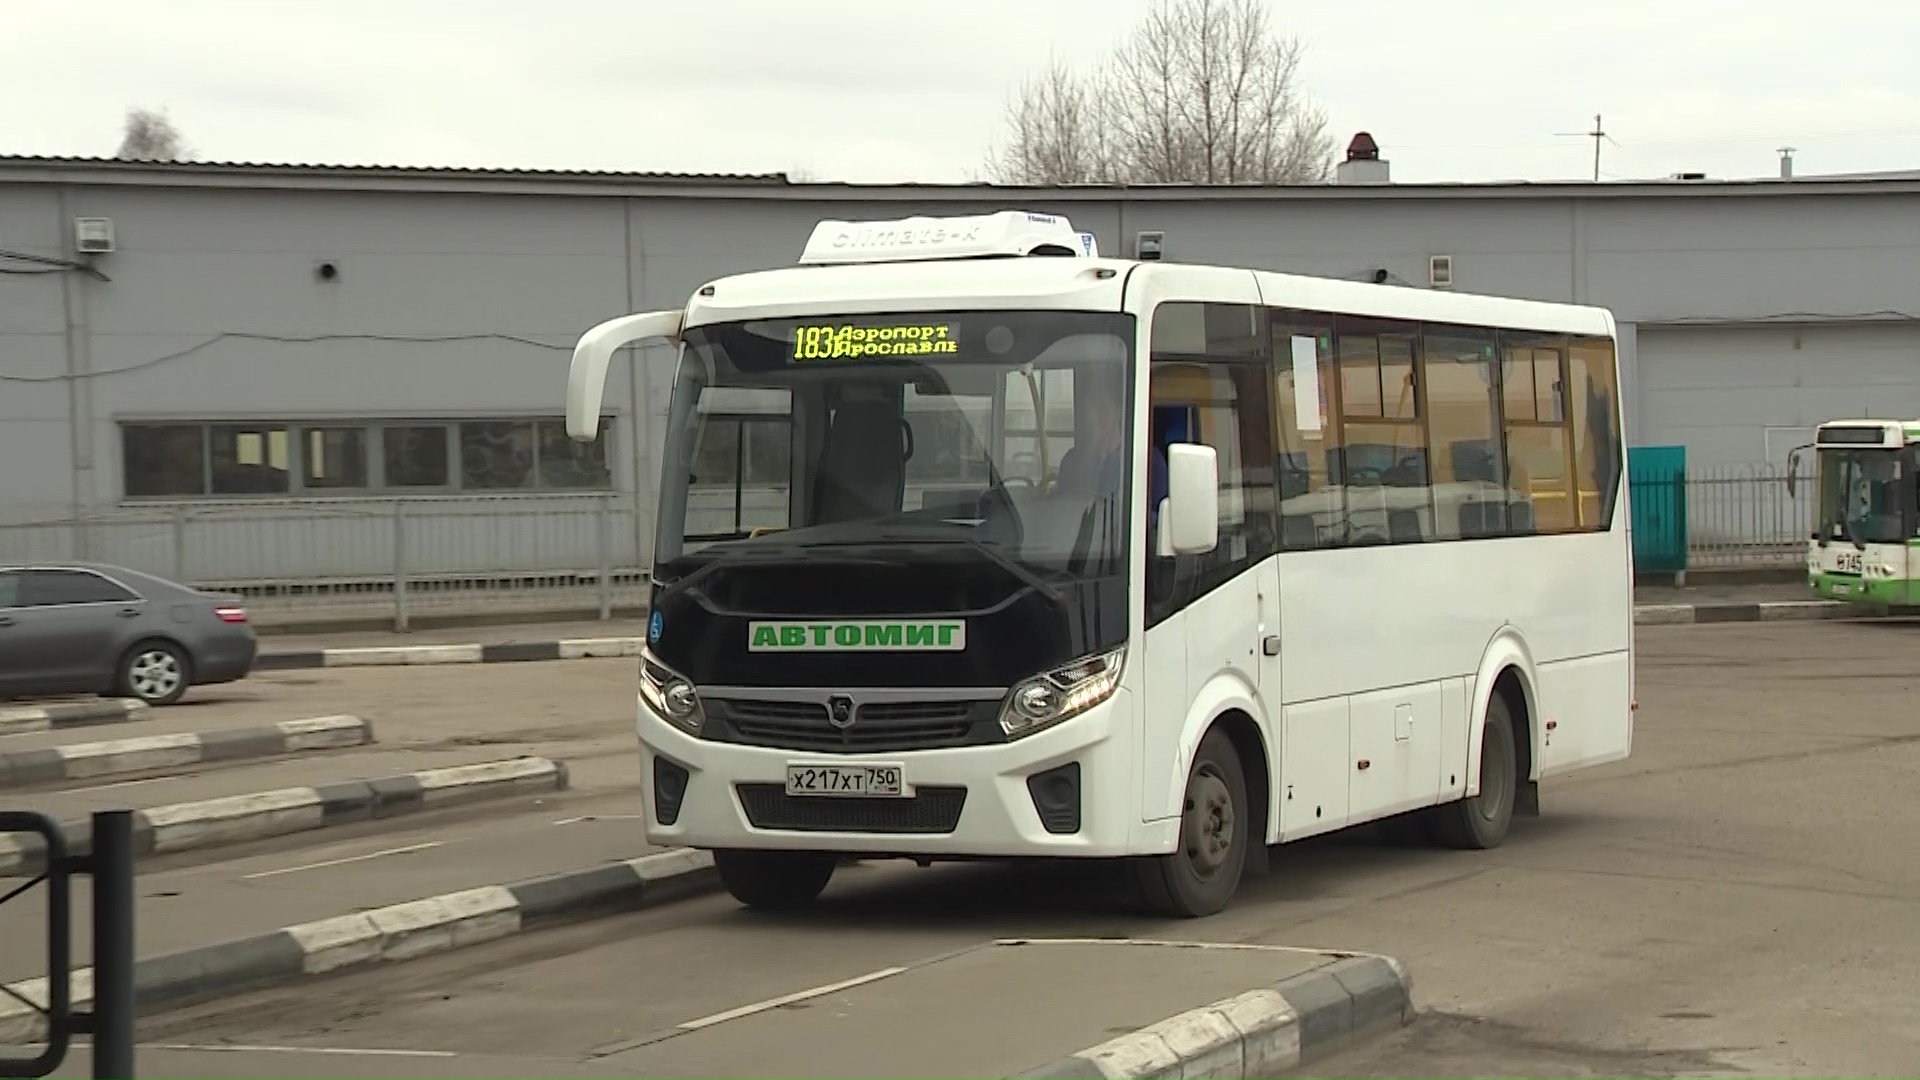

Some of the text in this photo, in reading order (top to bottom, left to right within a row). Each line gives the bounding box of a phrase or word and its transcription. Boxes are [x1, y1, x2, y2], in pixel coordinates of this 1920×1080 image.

[838, 325, 949, 343] Аэропорт
[752, 625, 961, 647] АВТОМИГ
[868, 769, 896, 786] 750
